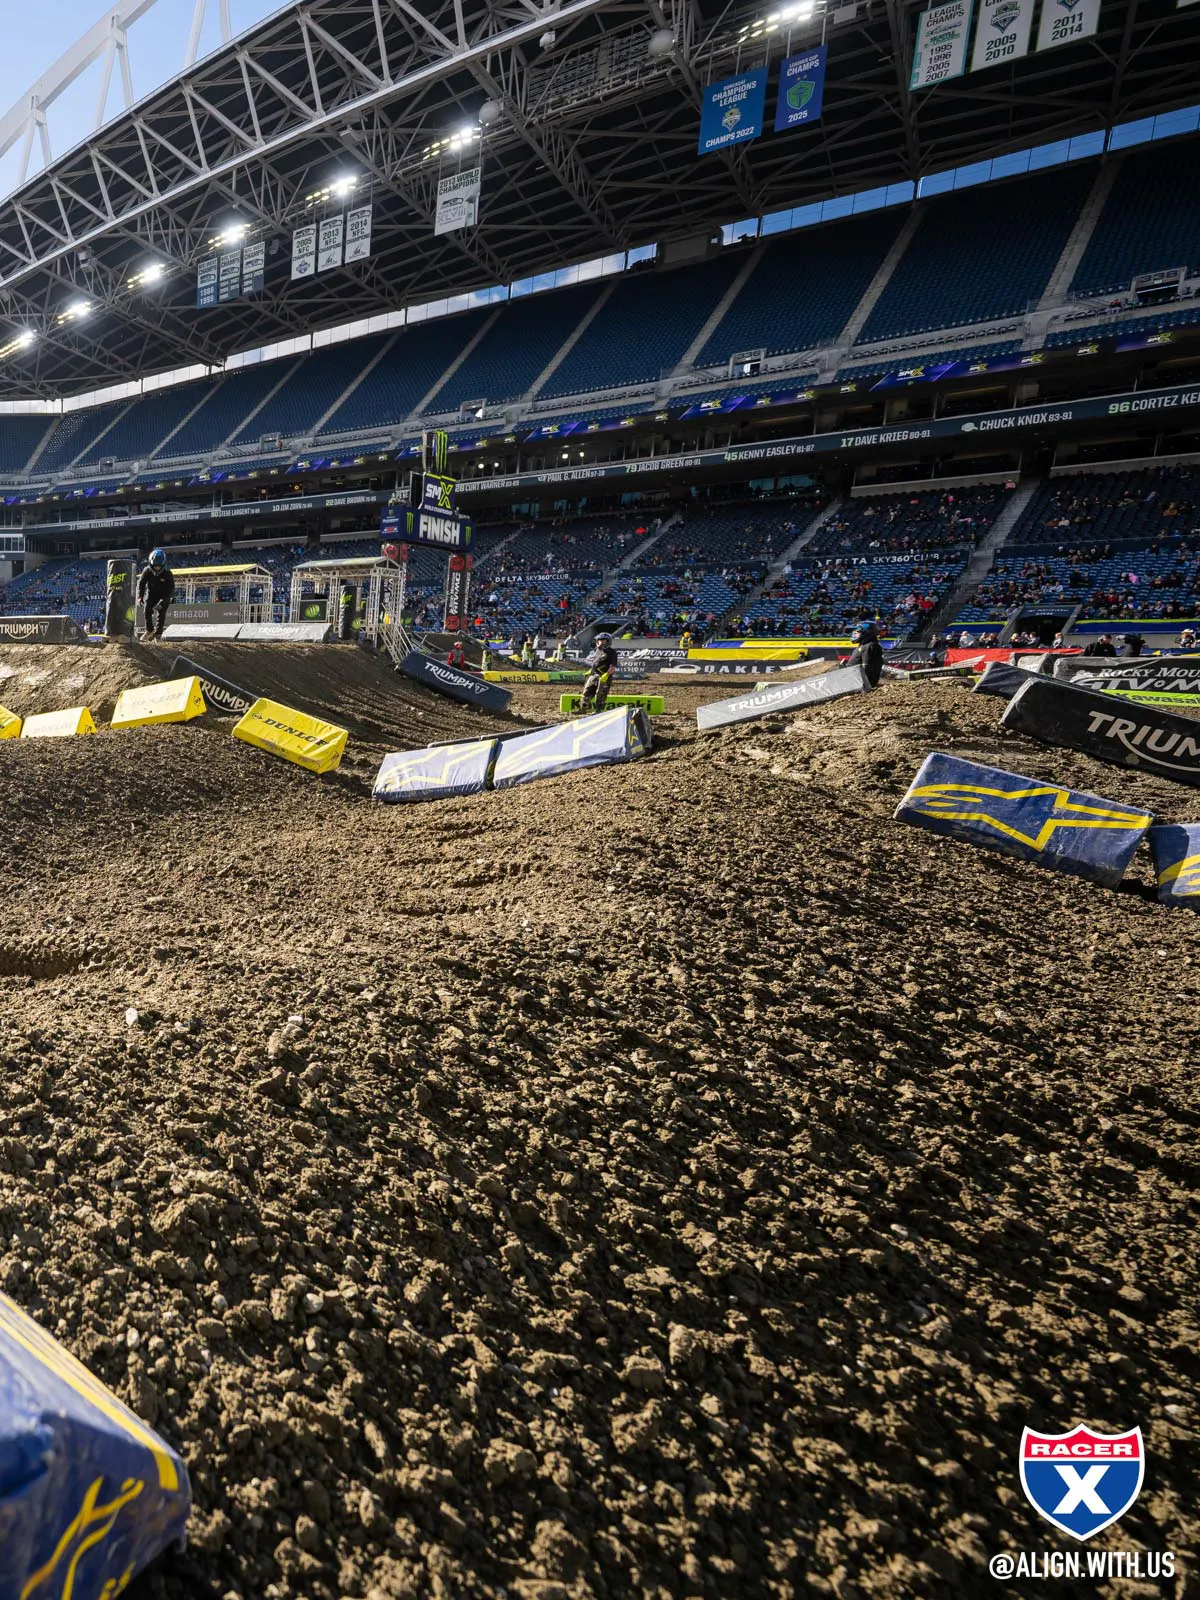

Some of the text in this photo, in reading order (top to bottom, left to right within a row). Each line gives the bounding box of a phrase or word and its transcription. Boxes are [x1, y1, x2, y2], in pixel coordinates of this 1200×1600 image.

[926, 9, 965, 28] CHAMPS
[929, 3, 963, 20] LEAGUE
[1052, 12, 1084, 29] 2011
[1051, 23, 1083, 41] 2014
[929, 43, 953, 55] 1995
[986, 33, 1017, 51] 2009
[928, 52, 952, 64] 1996
[984, 44, 1015, 62] 2010
[786, 59, 820, 77] CHAMPS
[926, 61, 950, 73] 2005
[925, 69, 950, 83] 2007
[712, 80, 757, 102] CHAMPIONS
[719, 92, 748, 107] LEAGUE
[787, 110, 808, 123] 2025
[705, 126, 755, 148] CHAMPS 2022
[457, 169, 480, 182] WORLD
[438, 176, 479, 196] CHAMPIONS
[350, 218, 368, 231] 2014
[322, 228, 339, 241] 2013
[1108, 401, 1131, 414] 96
[1131, 394, 1179, 412] CORTEZ
[979, 411, 1073, 431] CHUCK KNOX 83-91
[840, 430, 931, 448] 17 DAVE KRIEG 80-91
[723, 452, 738, 462] 45
[738, 447, 765, 461] KENNY
[766, 444, 797, 457] EASLEY
[625, 464, 637, 473] 79
[637, 461, 660, 472] JACOB
[660, 459, 684, 470] GREEN
[547, 473, 563, 482] PAUL
[571, 470, 590, 480] ALLEN
[465, 482, 480, 491] CURT
[480, 480, 505, 490] WARNER
[425, 481, 453, 509] SMX
[419, 513, 461, 546] FINISH
[495, 575, 523, 583] DELTA
[173, 608, 209, 619] amazon
[0, 622, 39, 639] TRIUMPH
[632, 648, 688, 659] MOUNTAIN
[424, 661, 474, 692] TRIUMPH
[704, 665, 776, 674] OAKLE
[1097, 667, 1154, 678] ROCKY
[728, 682, 807, 714] TRIUMPH
[263, 718, 330, 747] DUNLOP
